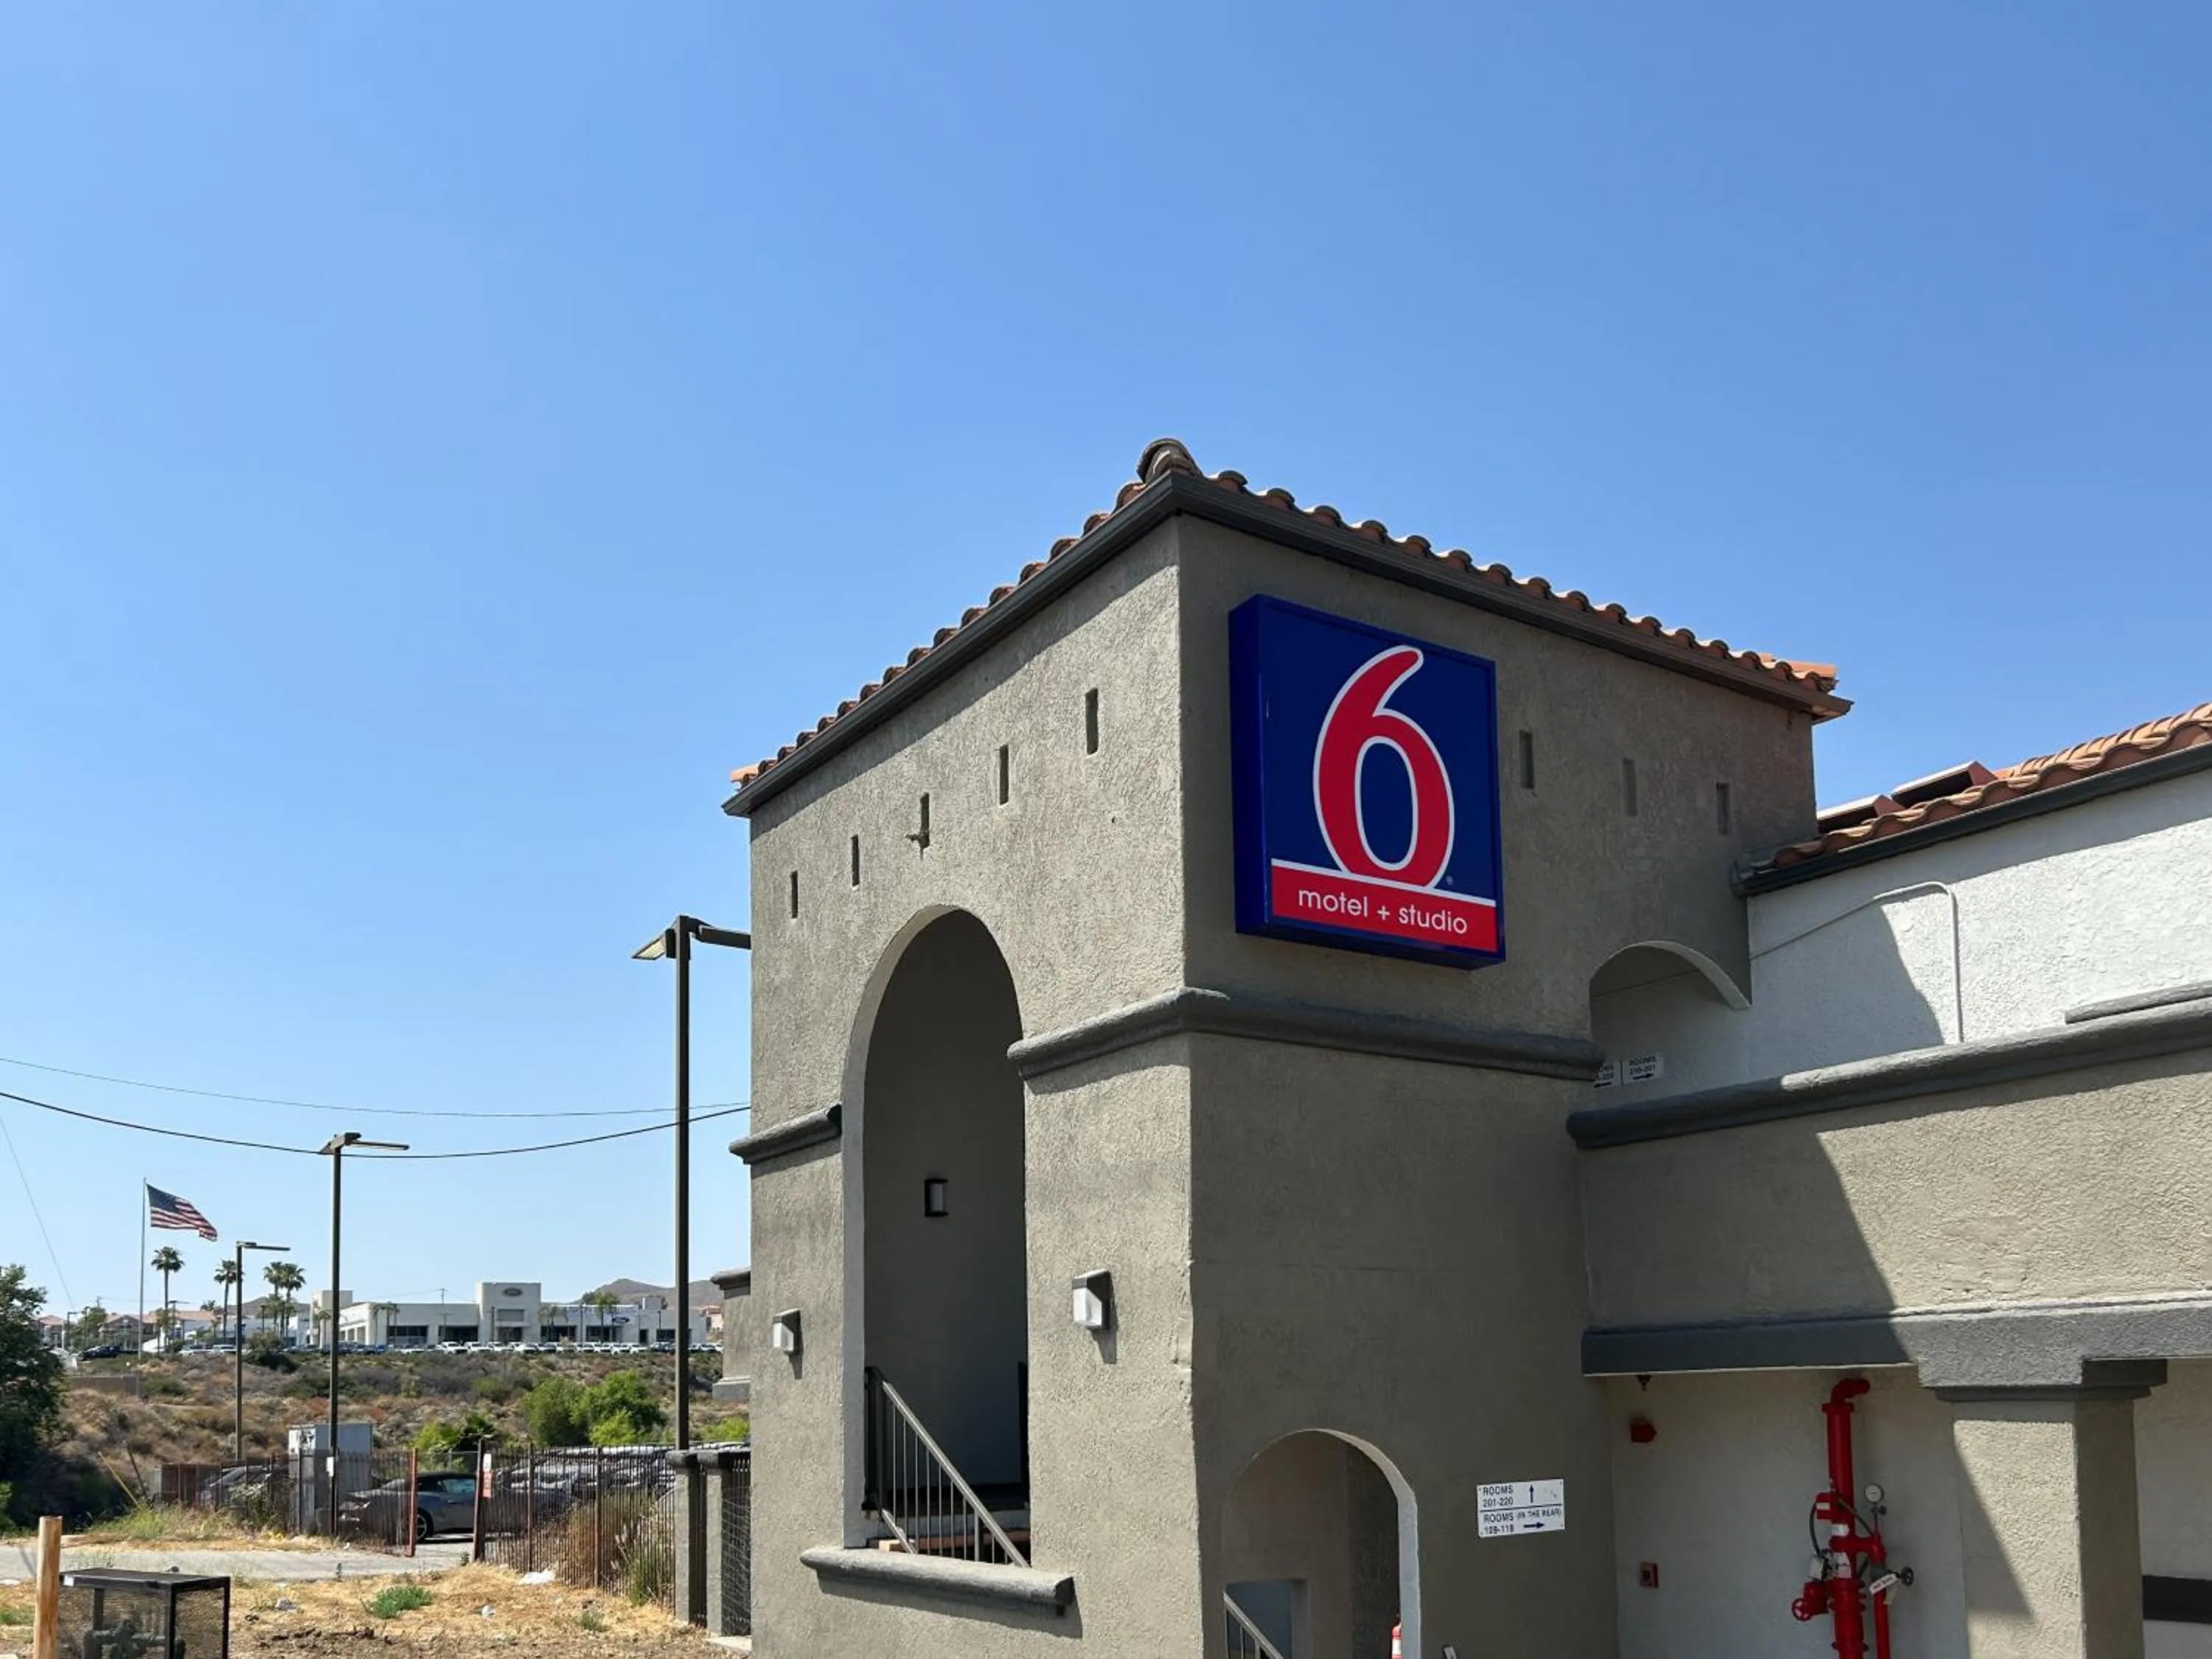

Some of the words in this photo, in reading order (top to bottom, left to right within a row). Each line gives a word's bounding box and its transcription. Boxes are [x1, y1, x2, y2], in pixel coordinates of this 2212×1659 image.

[1313, 644, 1455, 888] 6
[1298, 889, 1368, 917] motel
[1377, 905, 1391, 920] +
[1398, 904, 1467, 935] studio
[1483, 1484, 1514, 1496] ROOMS
[1483, 1496, 1514, 1507] 201-220
[1484, 1512, 1514, 1523] ROOMS
[1528, 1509, 1540, 1517] THE
